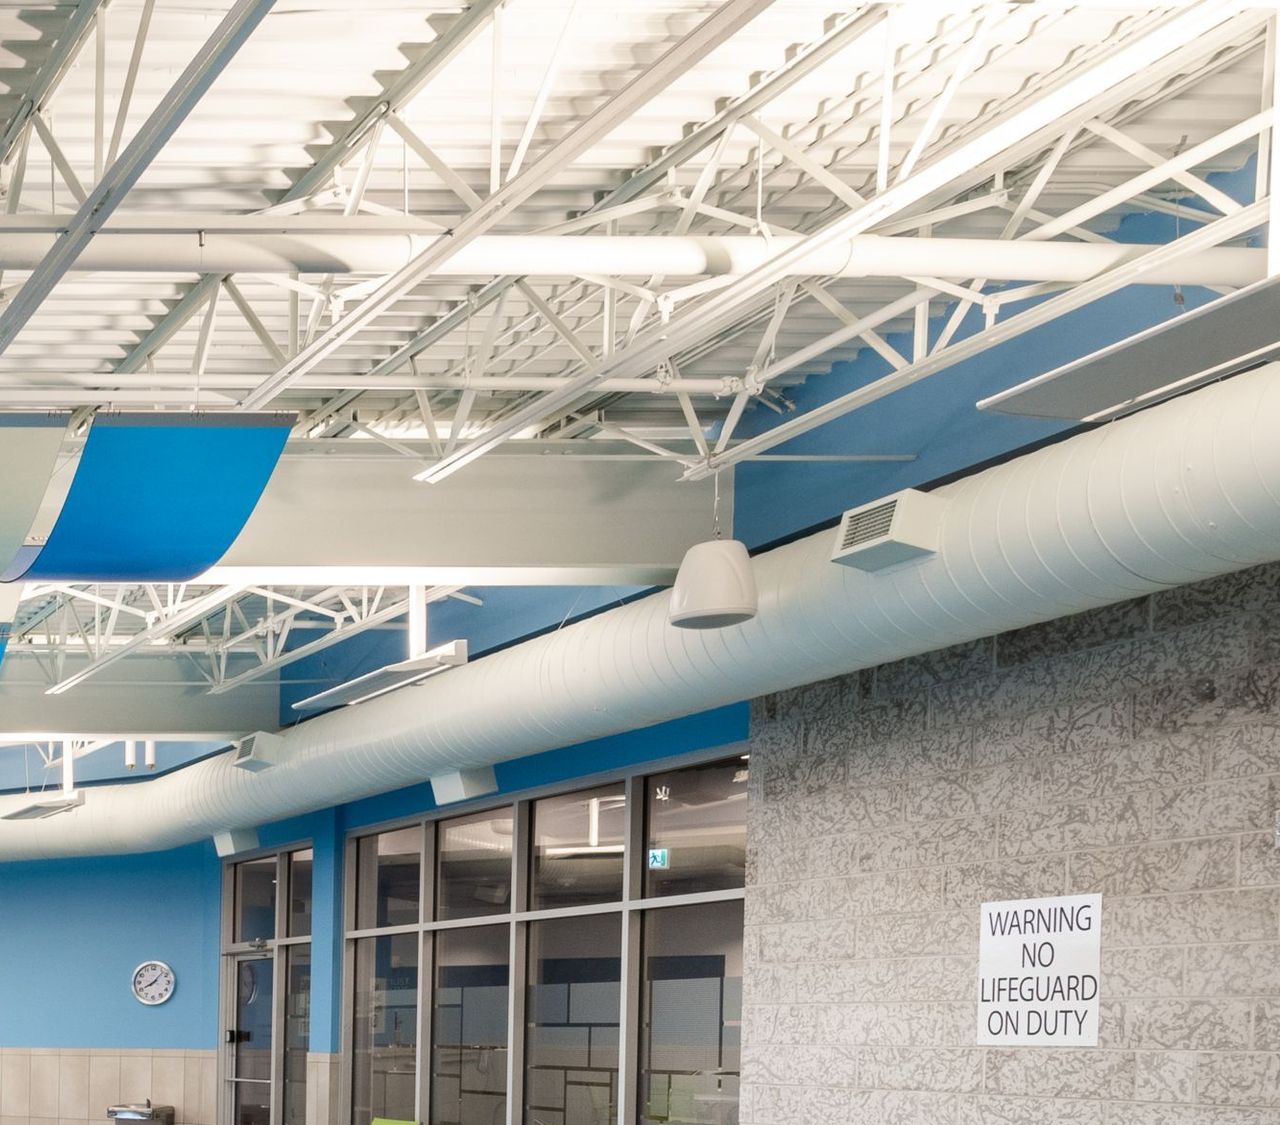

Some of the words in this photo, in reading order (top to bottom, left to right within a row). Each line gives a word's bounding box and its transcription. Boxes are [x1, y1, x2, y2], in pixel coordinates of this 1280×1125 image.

[989, 904, 1092, 936] WARNING
[1021, 941, 1055, 968] NO
[981, 974, 1098, 1002] LIFEGUARD
[987, 1010, 1019, 1035] ON
[1026, 1009, 1089, 1036] DUTY
